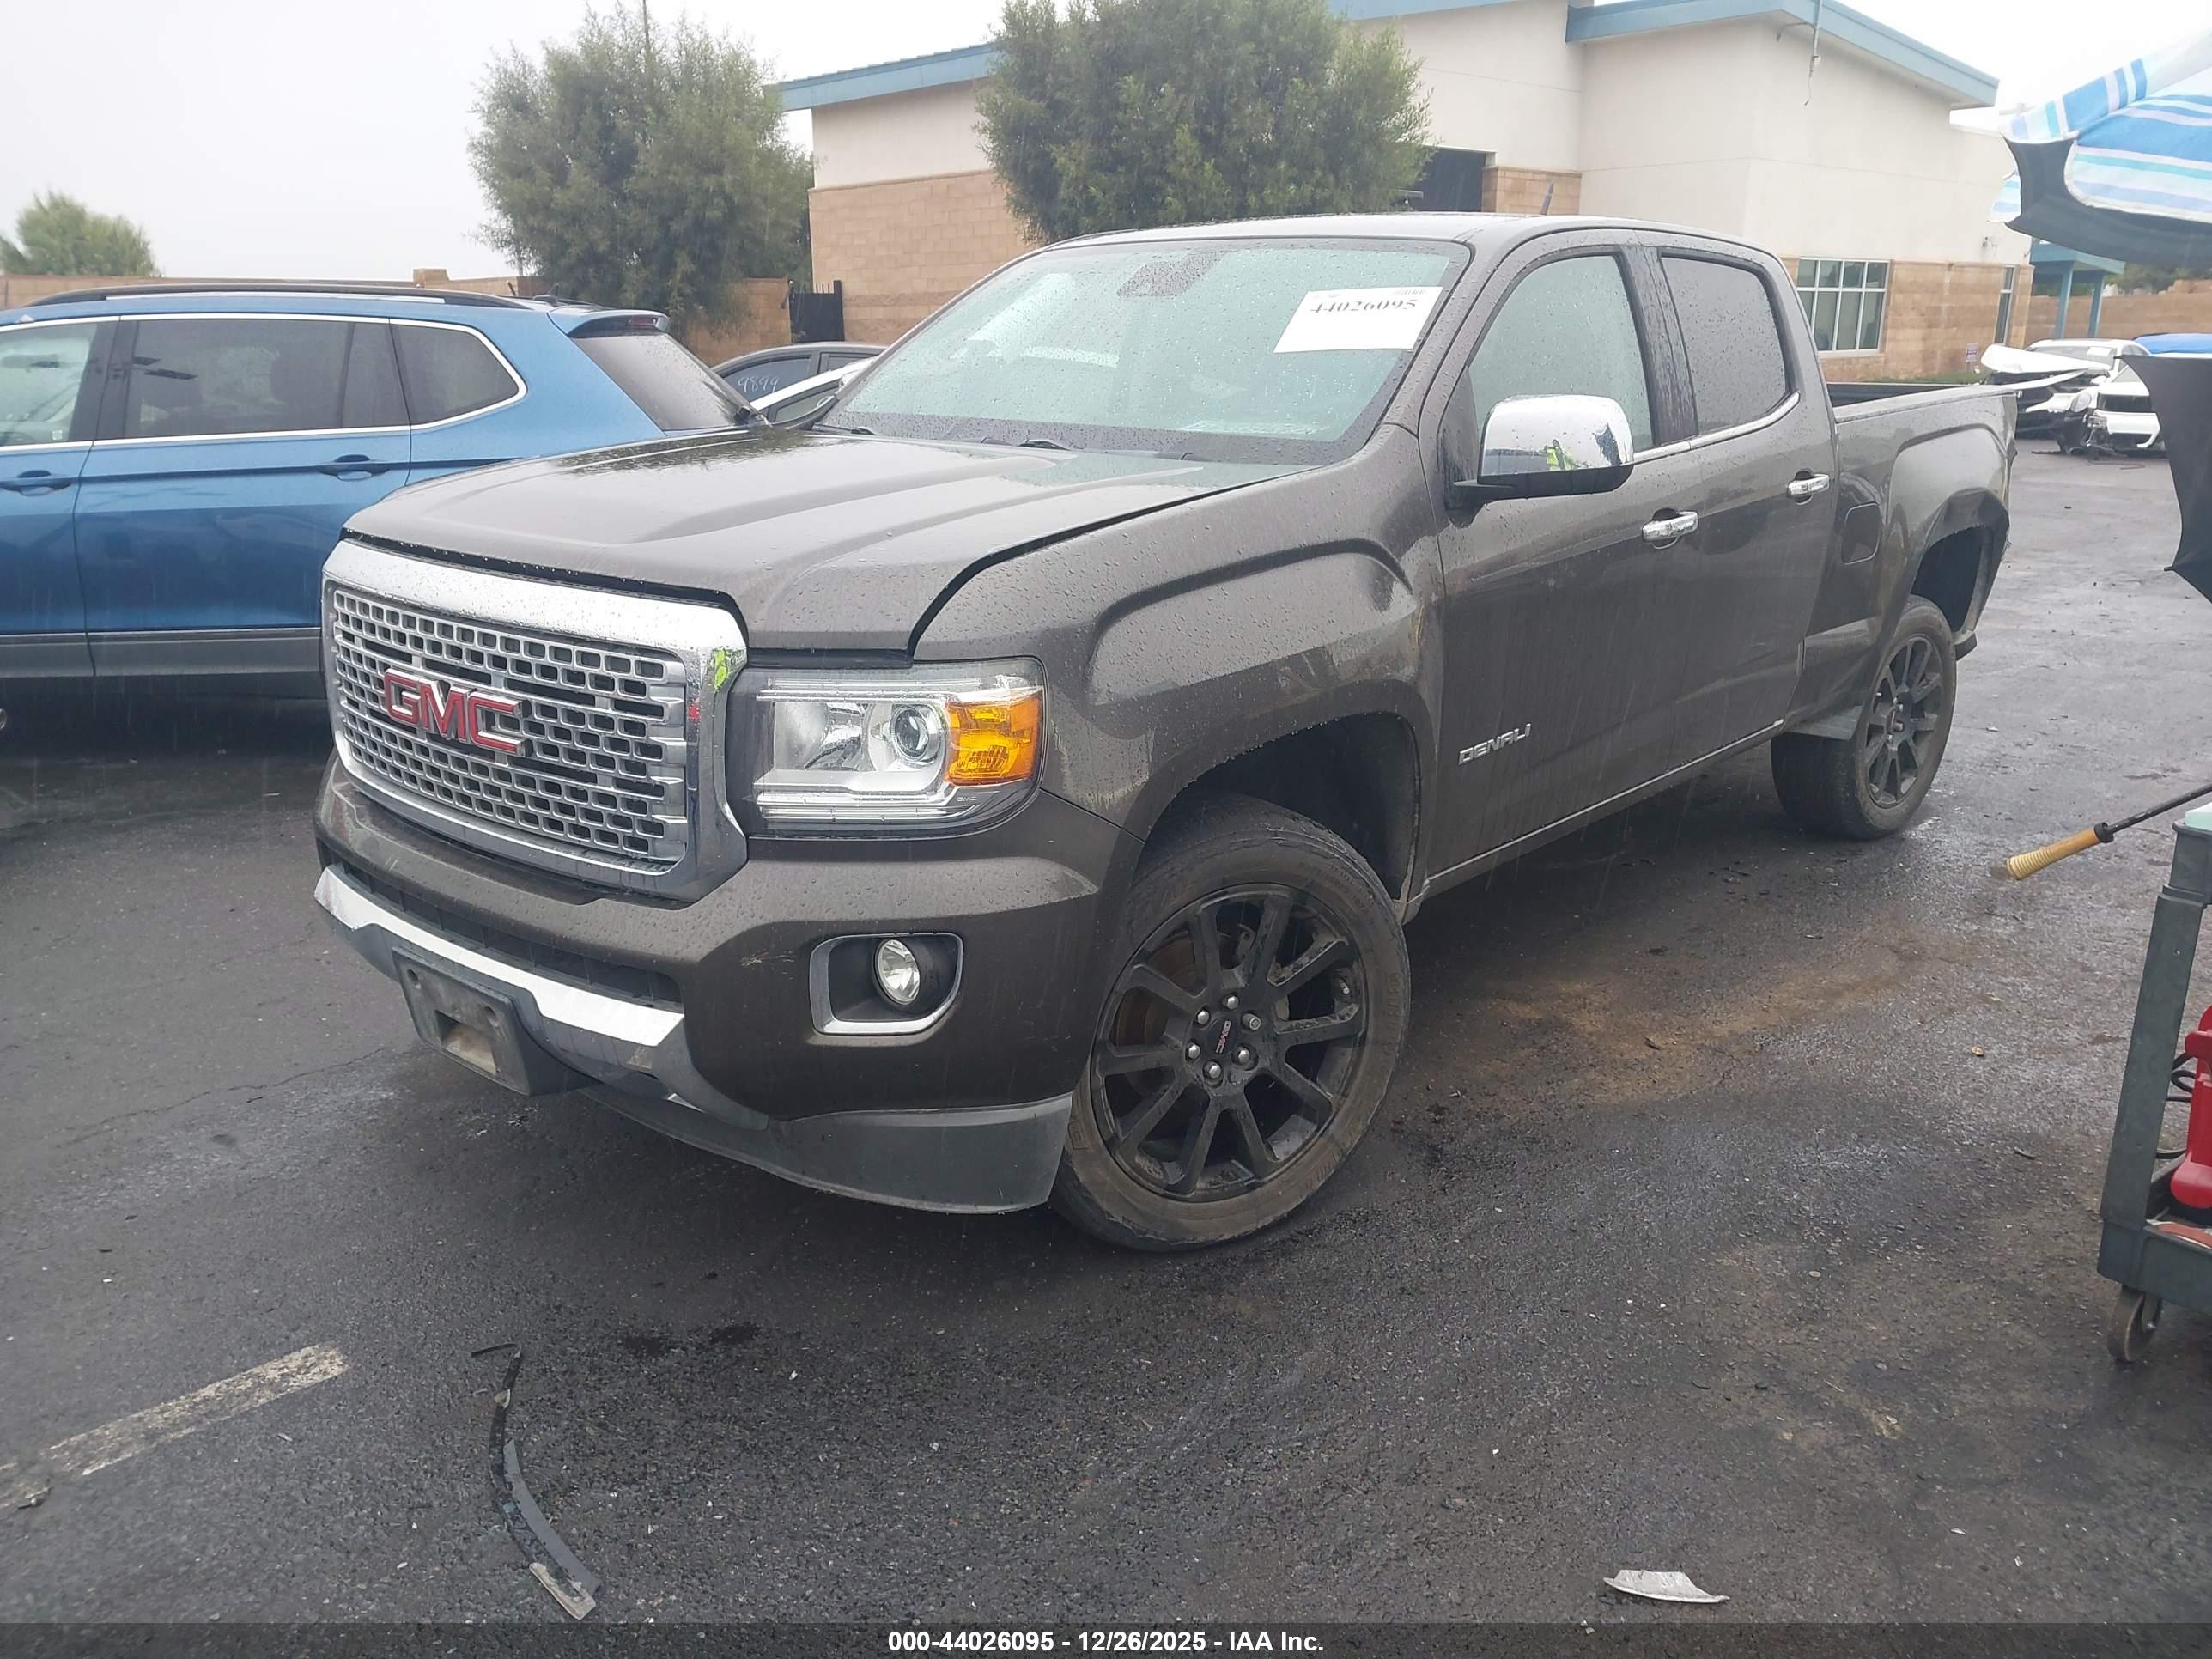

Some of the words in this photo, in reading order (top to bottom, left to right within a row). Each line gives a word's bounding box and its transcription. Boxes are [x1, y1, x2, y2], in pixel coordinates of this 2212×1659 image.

[1310, 299, 1419, 313] 44026095
[738, 376, 780, 392] 9899
[384, 667, 534, 757] GMC
[1459, 723, 1531, 764] DENALI
[1215, 1020, 1231, 1054] GMC
